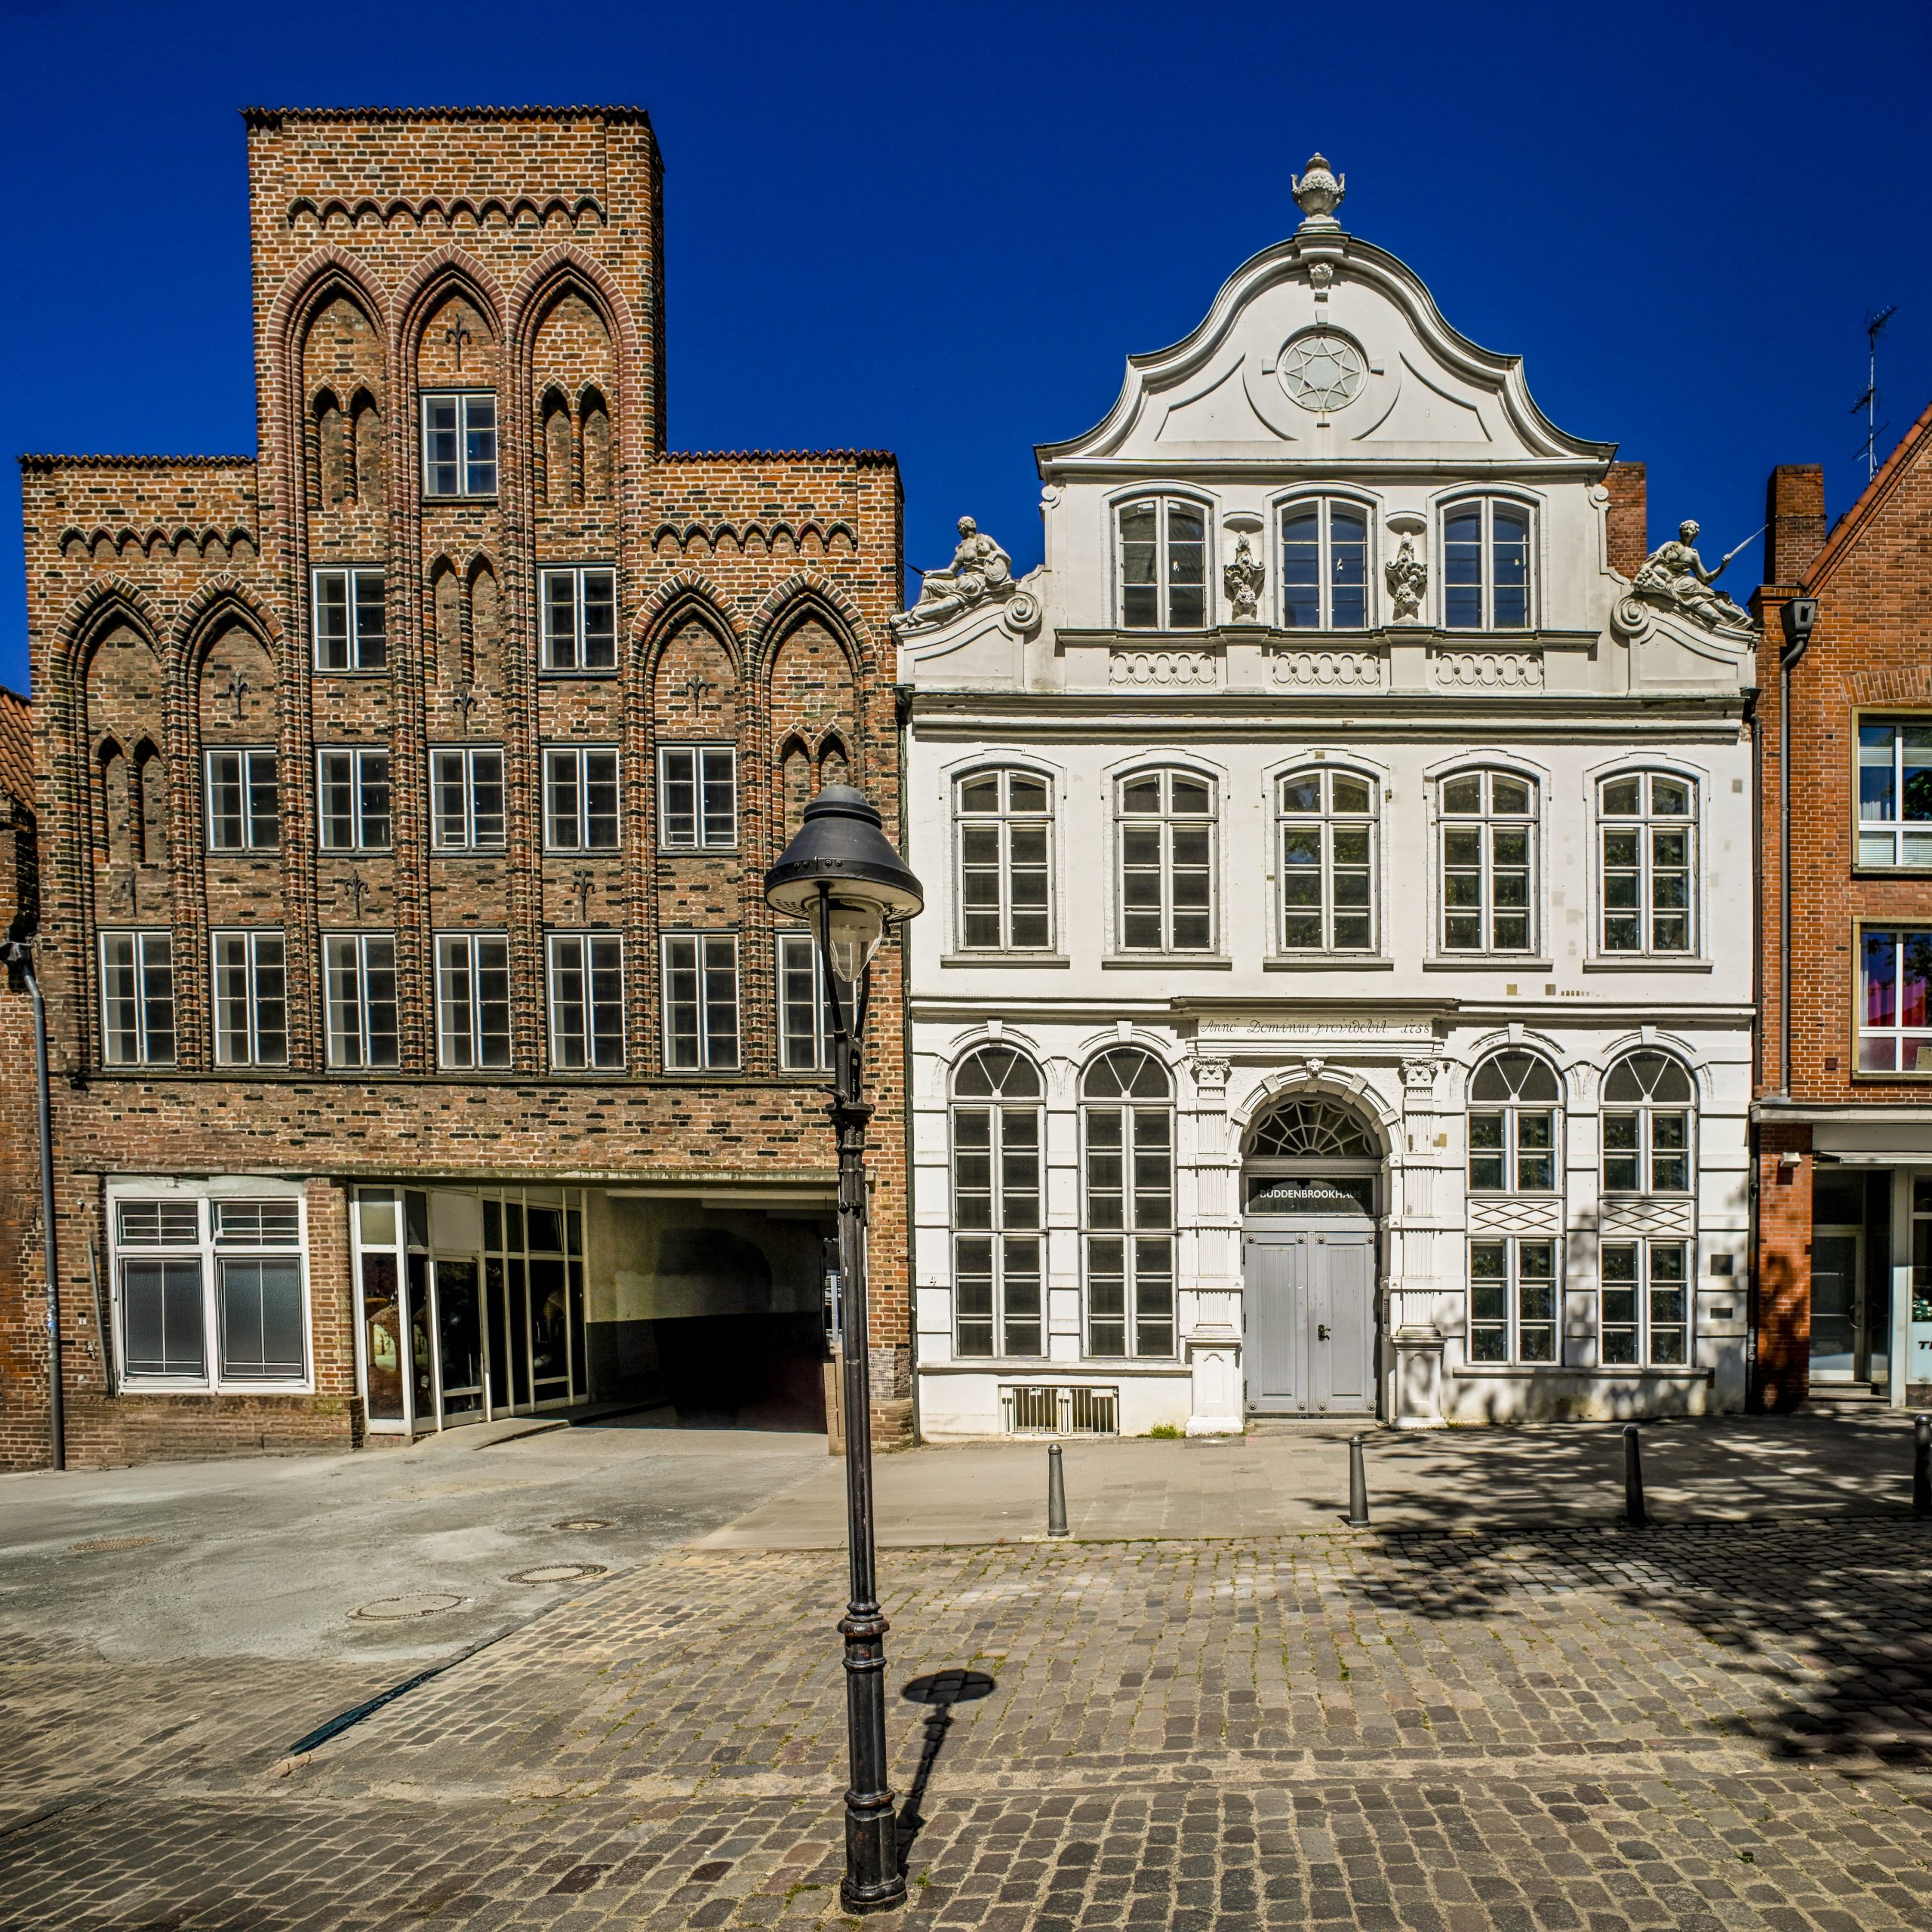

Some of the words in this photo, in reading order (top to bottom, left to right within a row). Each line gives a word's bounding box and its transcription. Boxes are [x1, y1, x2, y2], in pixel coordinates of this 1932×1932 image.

[1247, 1020, 1310, 1033] Dominus
[1401, 1023, 1430, 1034] 1758
[1918, 1341, 1932, 1349] T
